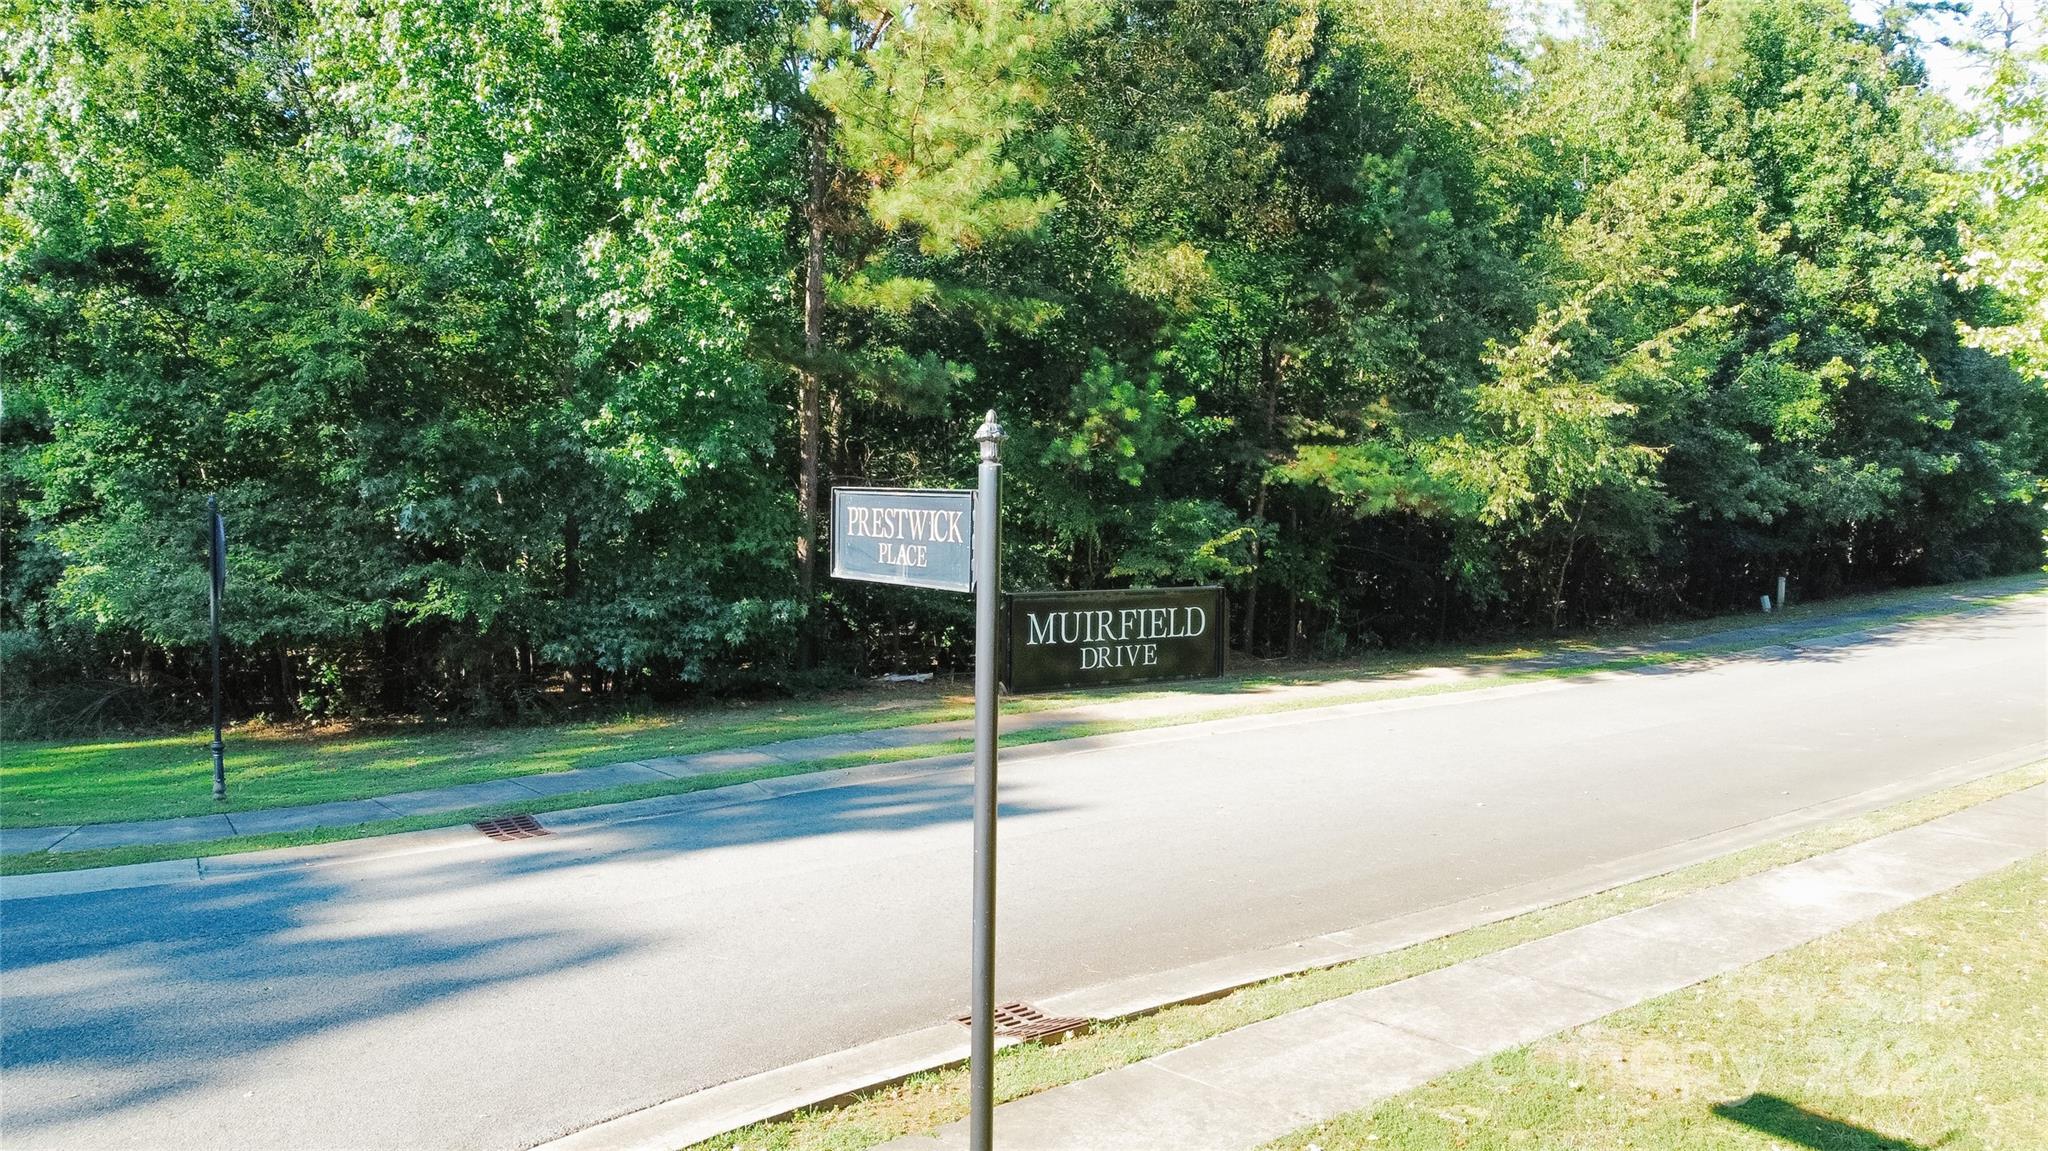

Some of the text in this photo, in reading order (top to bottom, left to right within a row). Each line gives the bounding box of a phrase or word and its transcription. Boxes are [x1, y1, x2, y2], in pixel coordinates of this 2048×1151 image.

[846, 506, 964, 544] PRESTWICK
[878, 542, 928, 568] PLACE
[1026, 605, 1207, 646] MUIRFIELD
[1079, 643, 1158, 670] DRIVE
